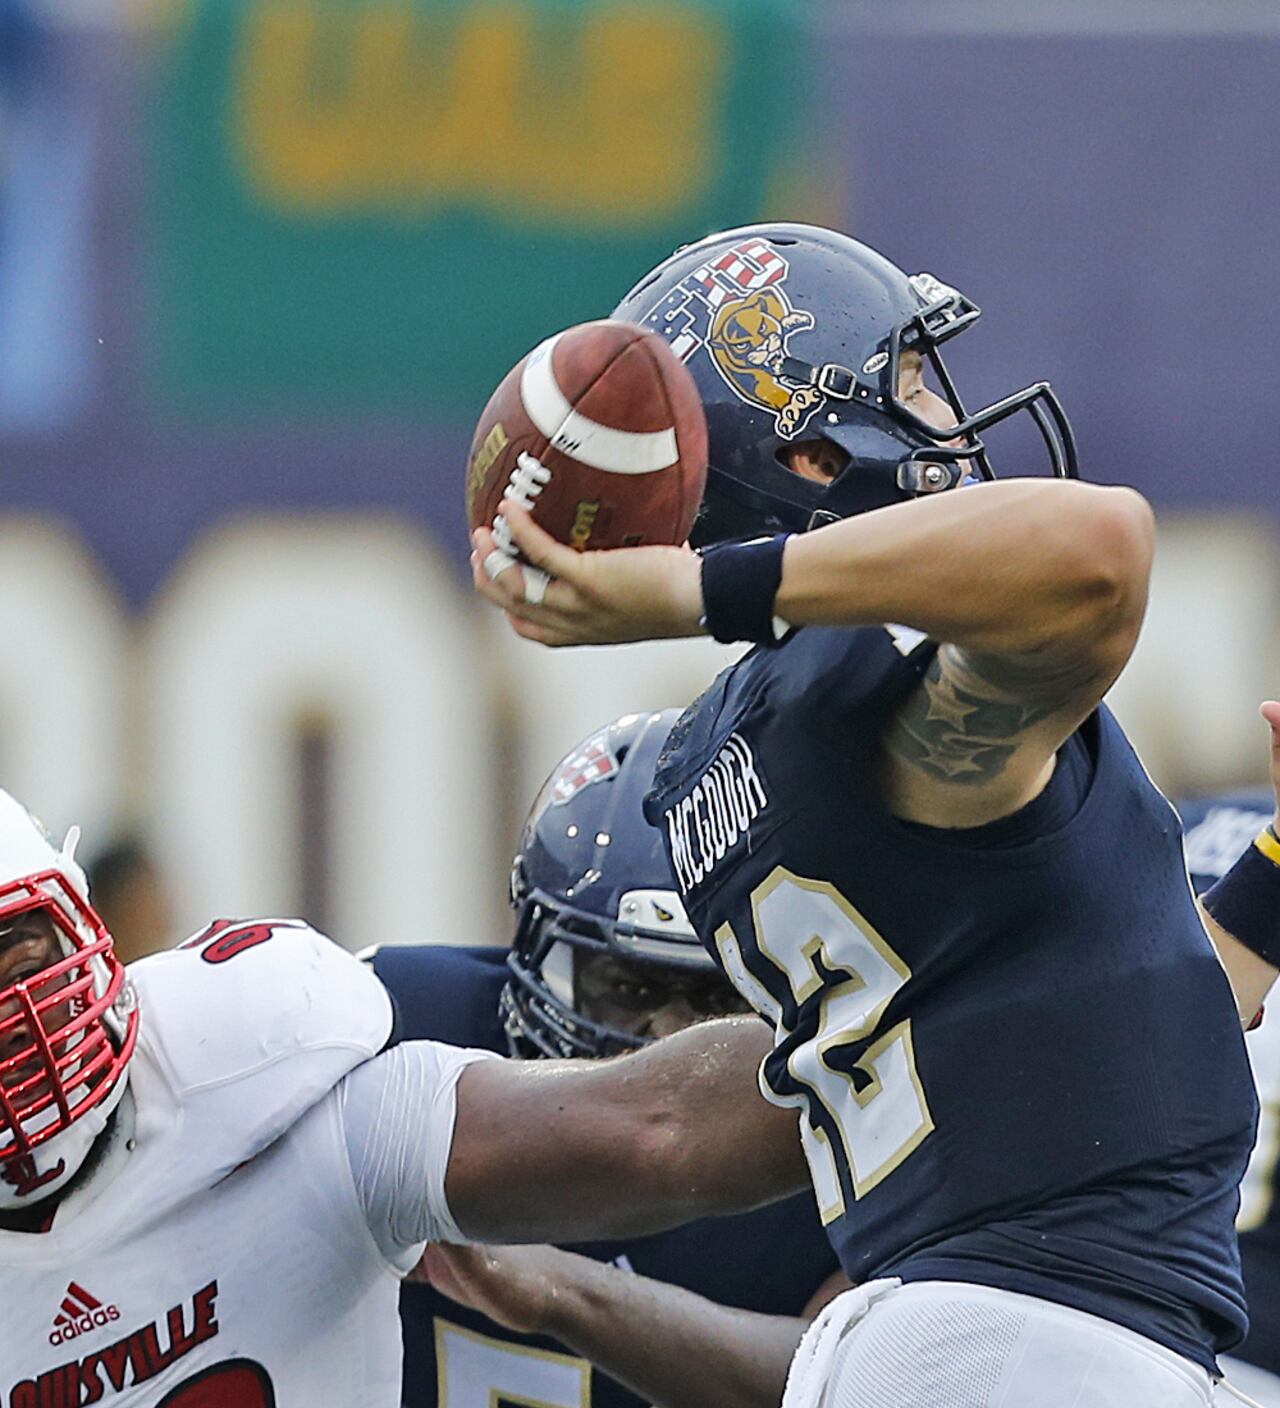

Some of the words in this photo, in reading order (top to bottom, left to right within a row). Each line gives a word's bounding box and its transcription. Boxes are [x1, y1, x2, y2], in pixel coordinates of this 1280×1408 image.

[665, 732, 768, 896] MCGOUGH
[714, 865, 935, 1227] 12
[48, 1303, 121, 1347] adidas
